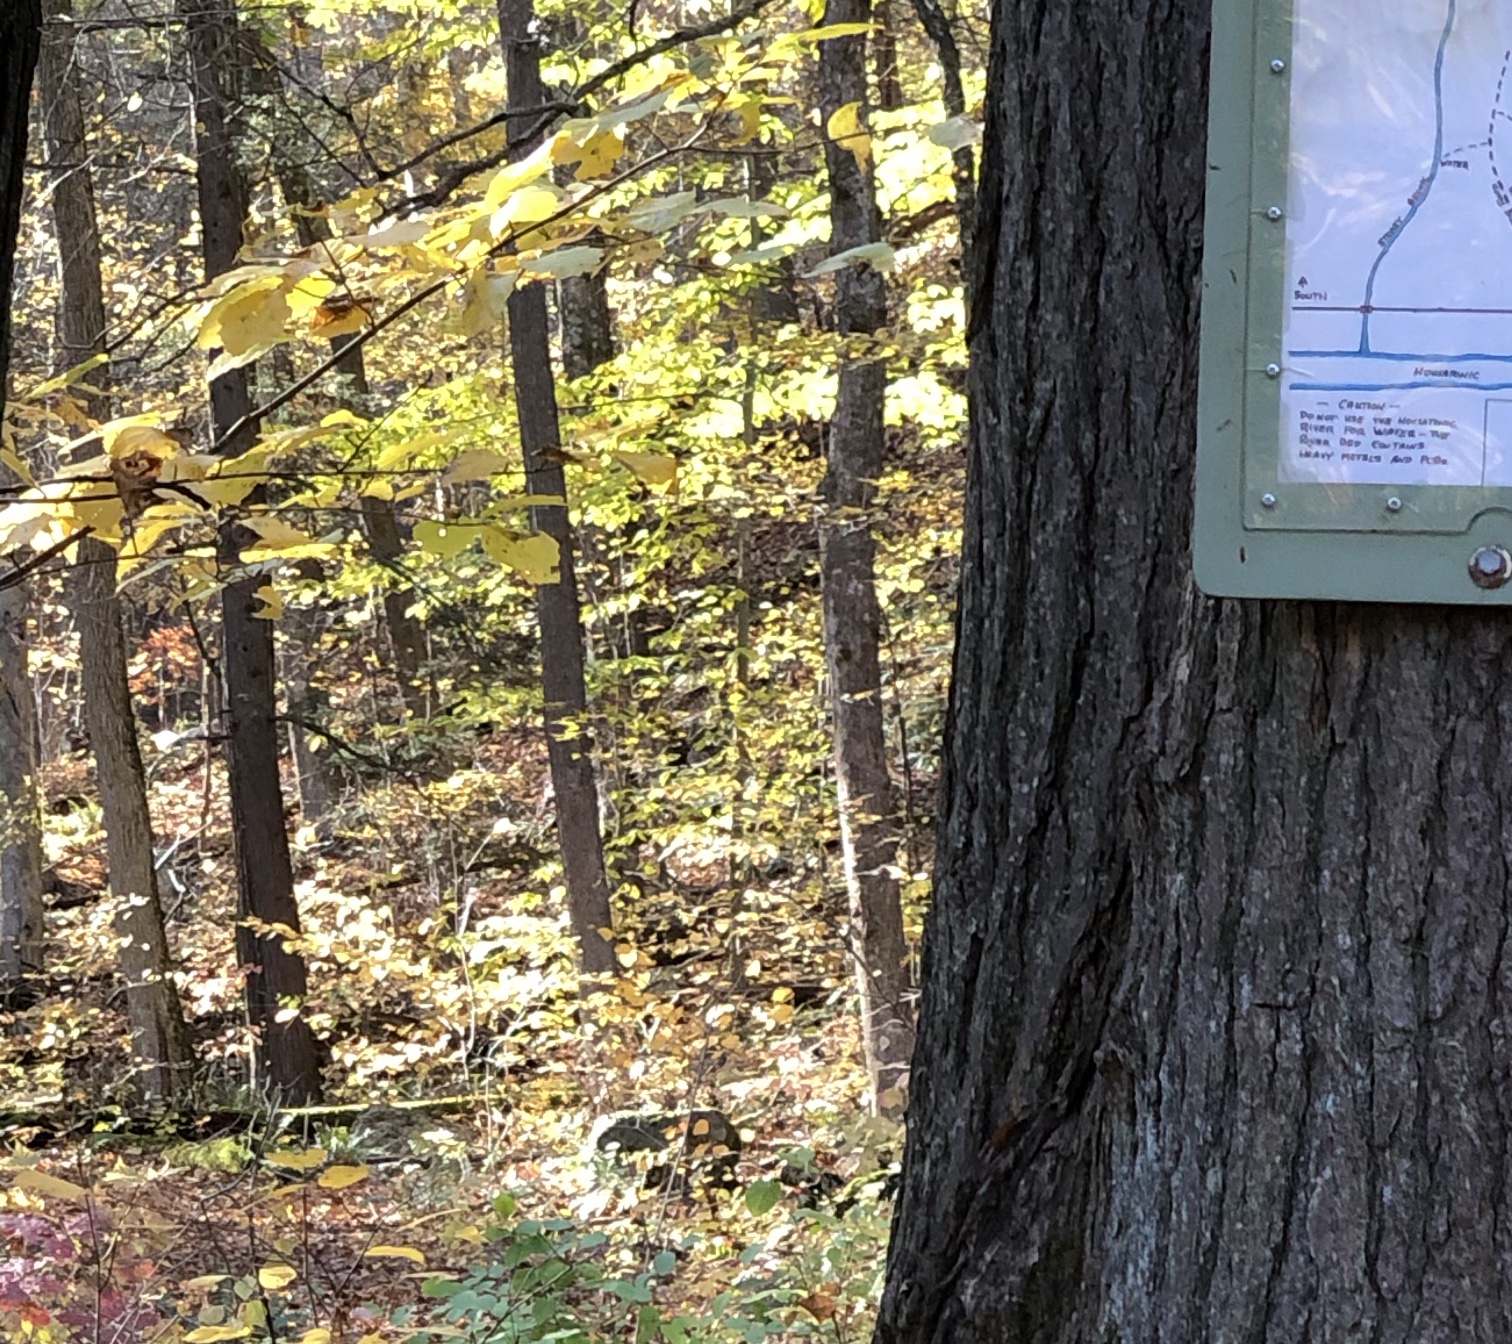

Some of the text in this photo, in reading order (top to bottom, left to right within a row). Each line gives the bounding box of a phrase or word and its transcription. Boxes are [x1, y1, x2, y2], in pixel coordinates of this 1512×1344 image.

[1338, 399, 1386, 411] CAUTION
[1300, 411, 1314, 420] DO
[1316, 413, 1338, 421] NOT
[1344, 415, 1365, 424] USE
[1373, 417, 1392, 425] THE
[1300, 422, 1334, 434] RIVER
[1344, 426, 1366, 436] FOR
[1373, 427, 1415, 438] WATER
[1299, 434, 1425, 450] RIVER BED CONTAINS
[1299, 450, 1334, 460] HEAVY
[1341, 452, 1382, 463] METALS
[1390, 455, 1413, 464] AND
